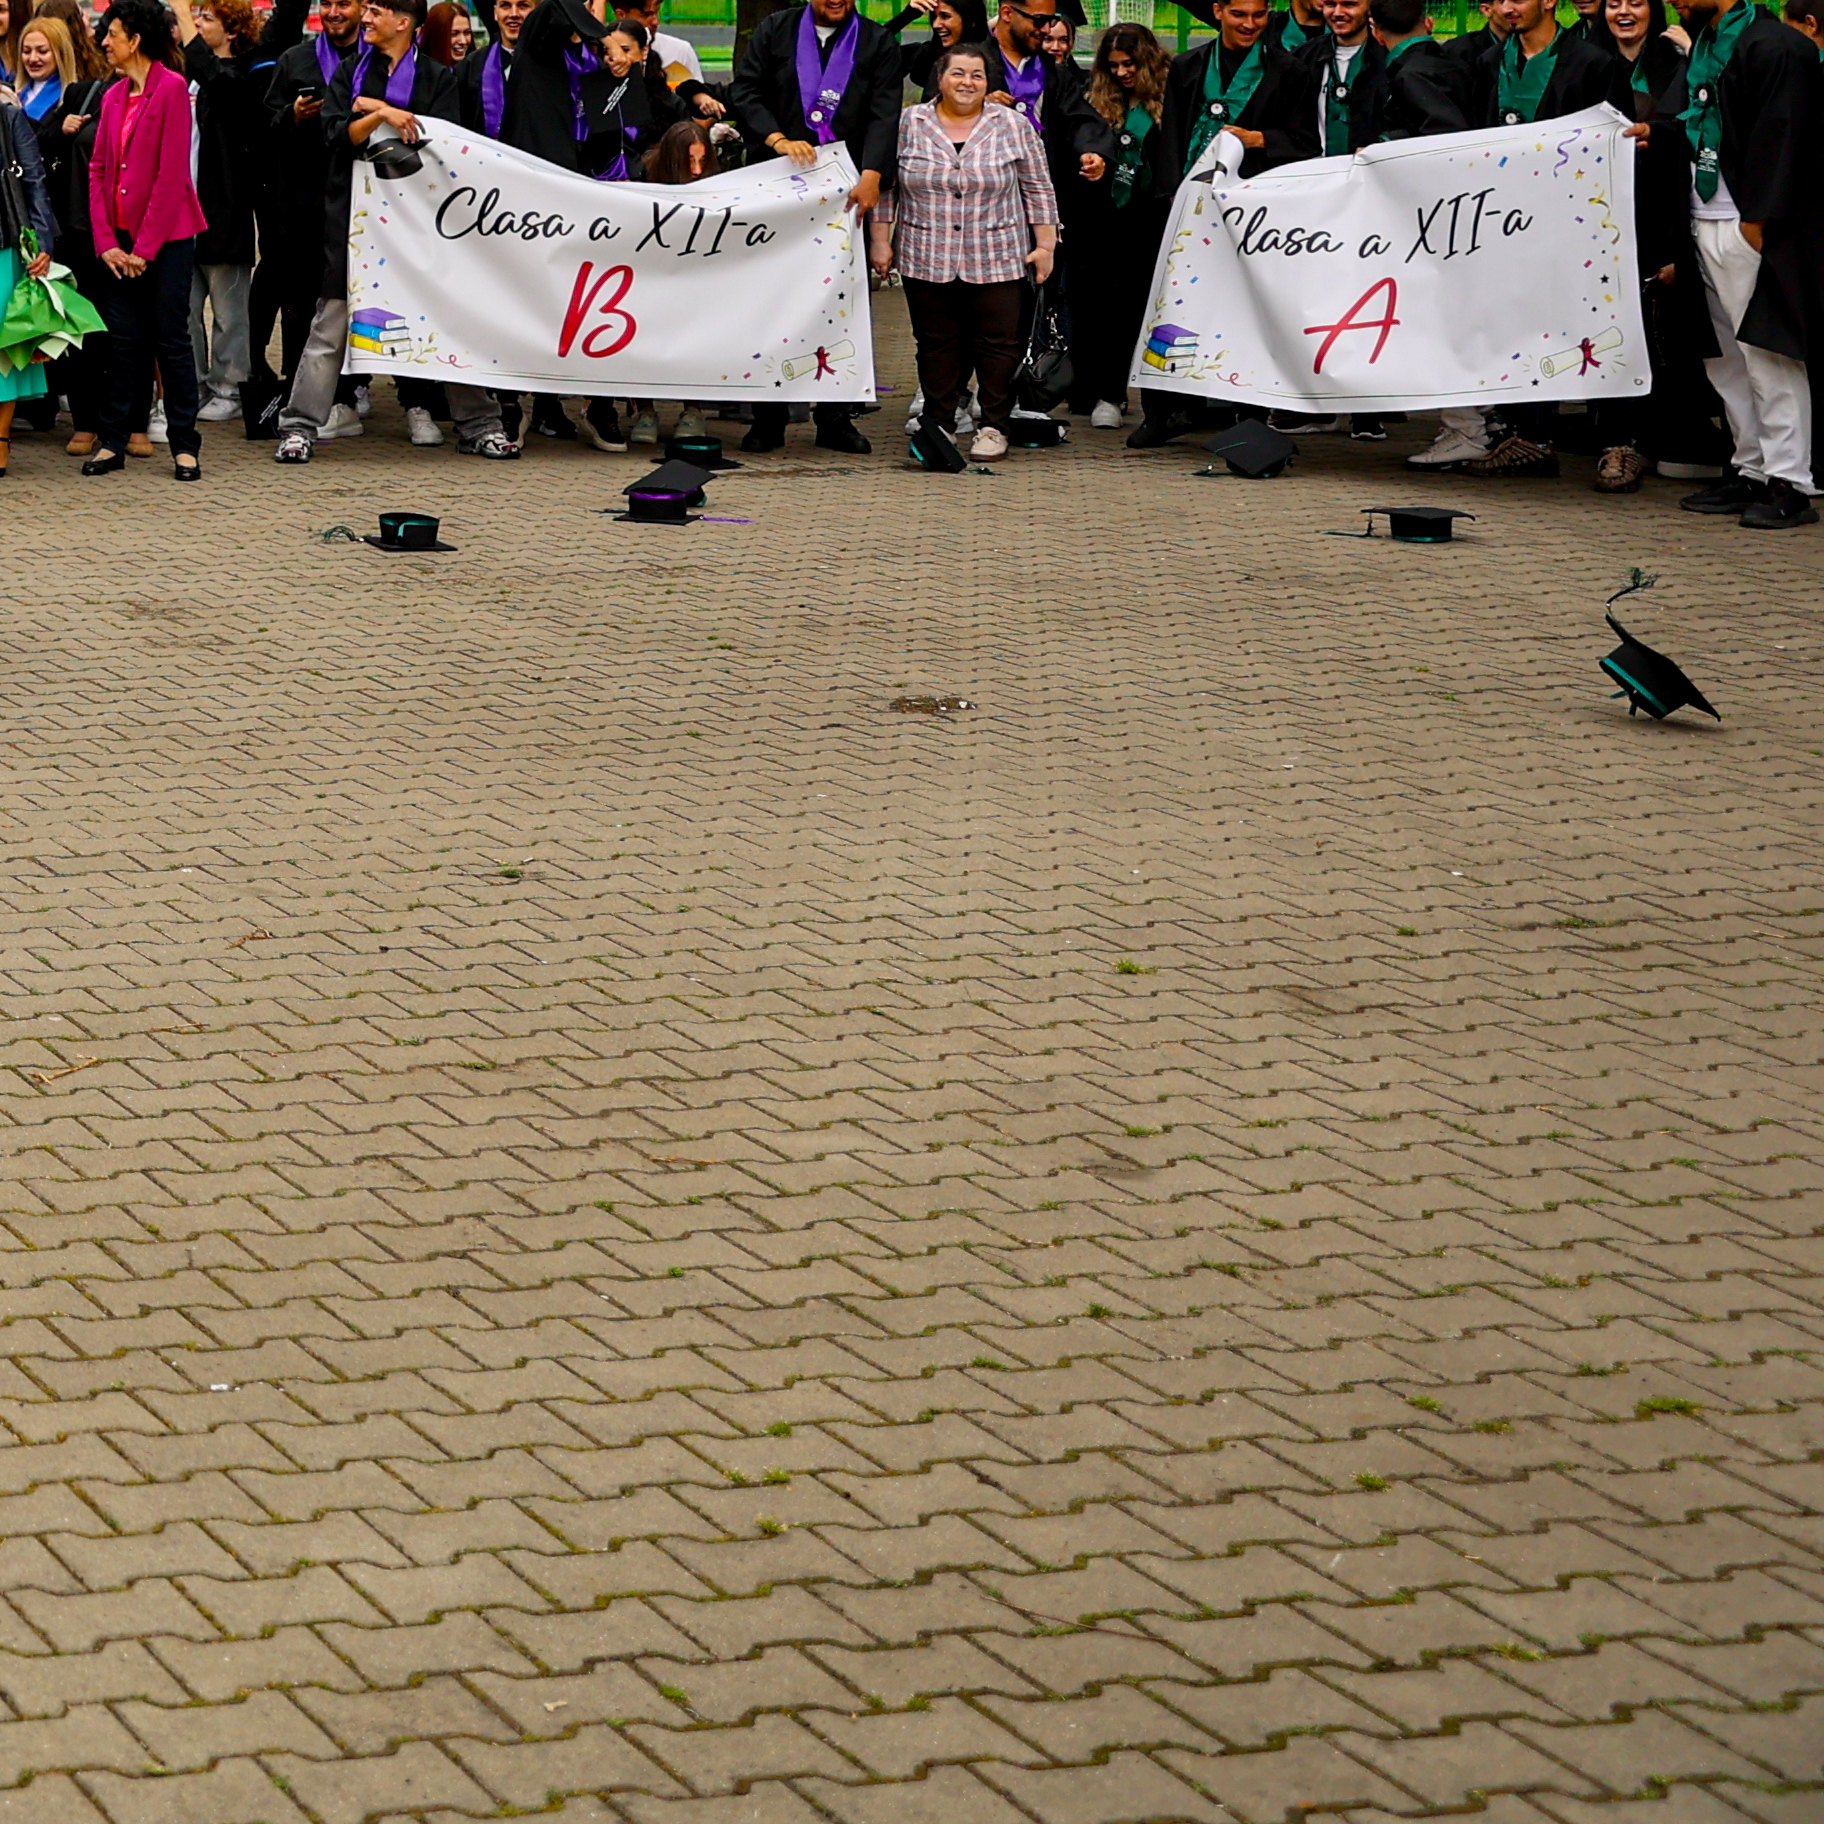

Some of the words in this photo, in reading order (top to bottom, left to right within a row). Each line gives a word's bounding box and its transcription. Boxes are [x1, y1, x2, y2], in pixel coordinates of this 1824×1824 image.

[435, 186, 575, 240] Clasa
[588, 217, 622, 241] a
[635, 202, 777, 257] XII-a
[1358, 234, 1391, 259] a
[1404, 187, 1534, 264] XII-a
[558, 261, 638, 359] B
[1303, 276, 1401, 375] A
